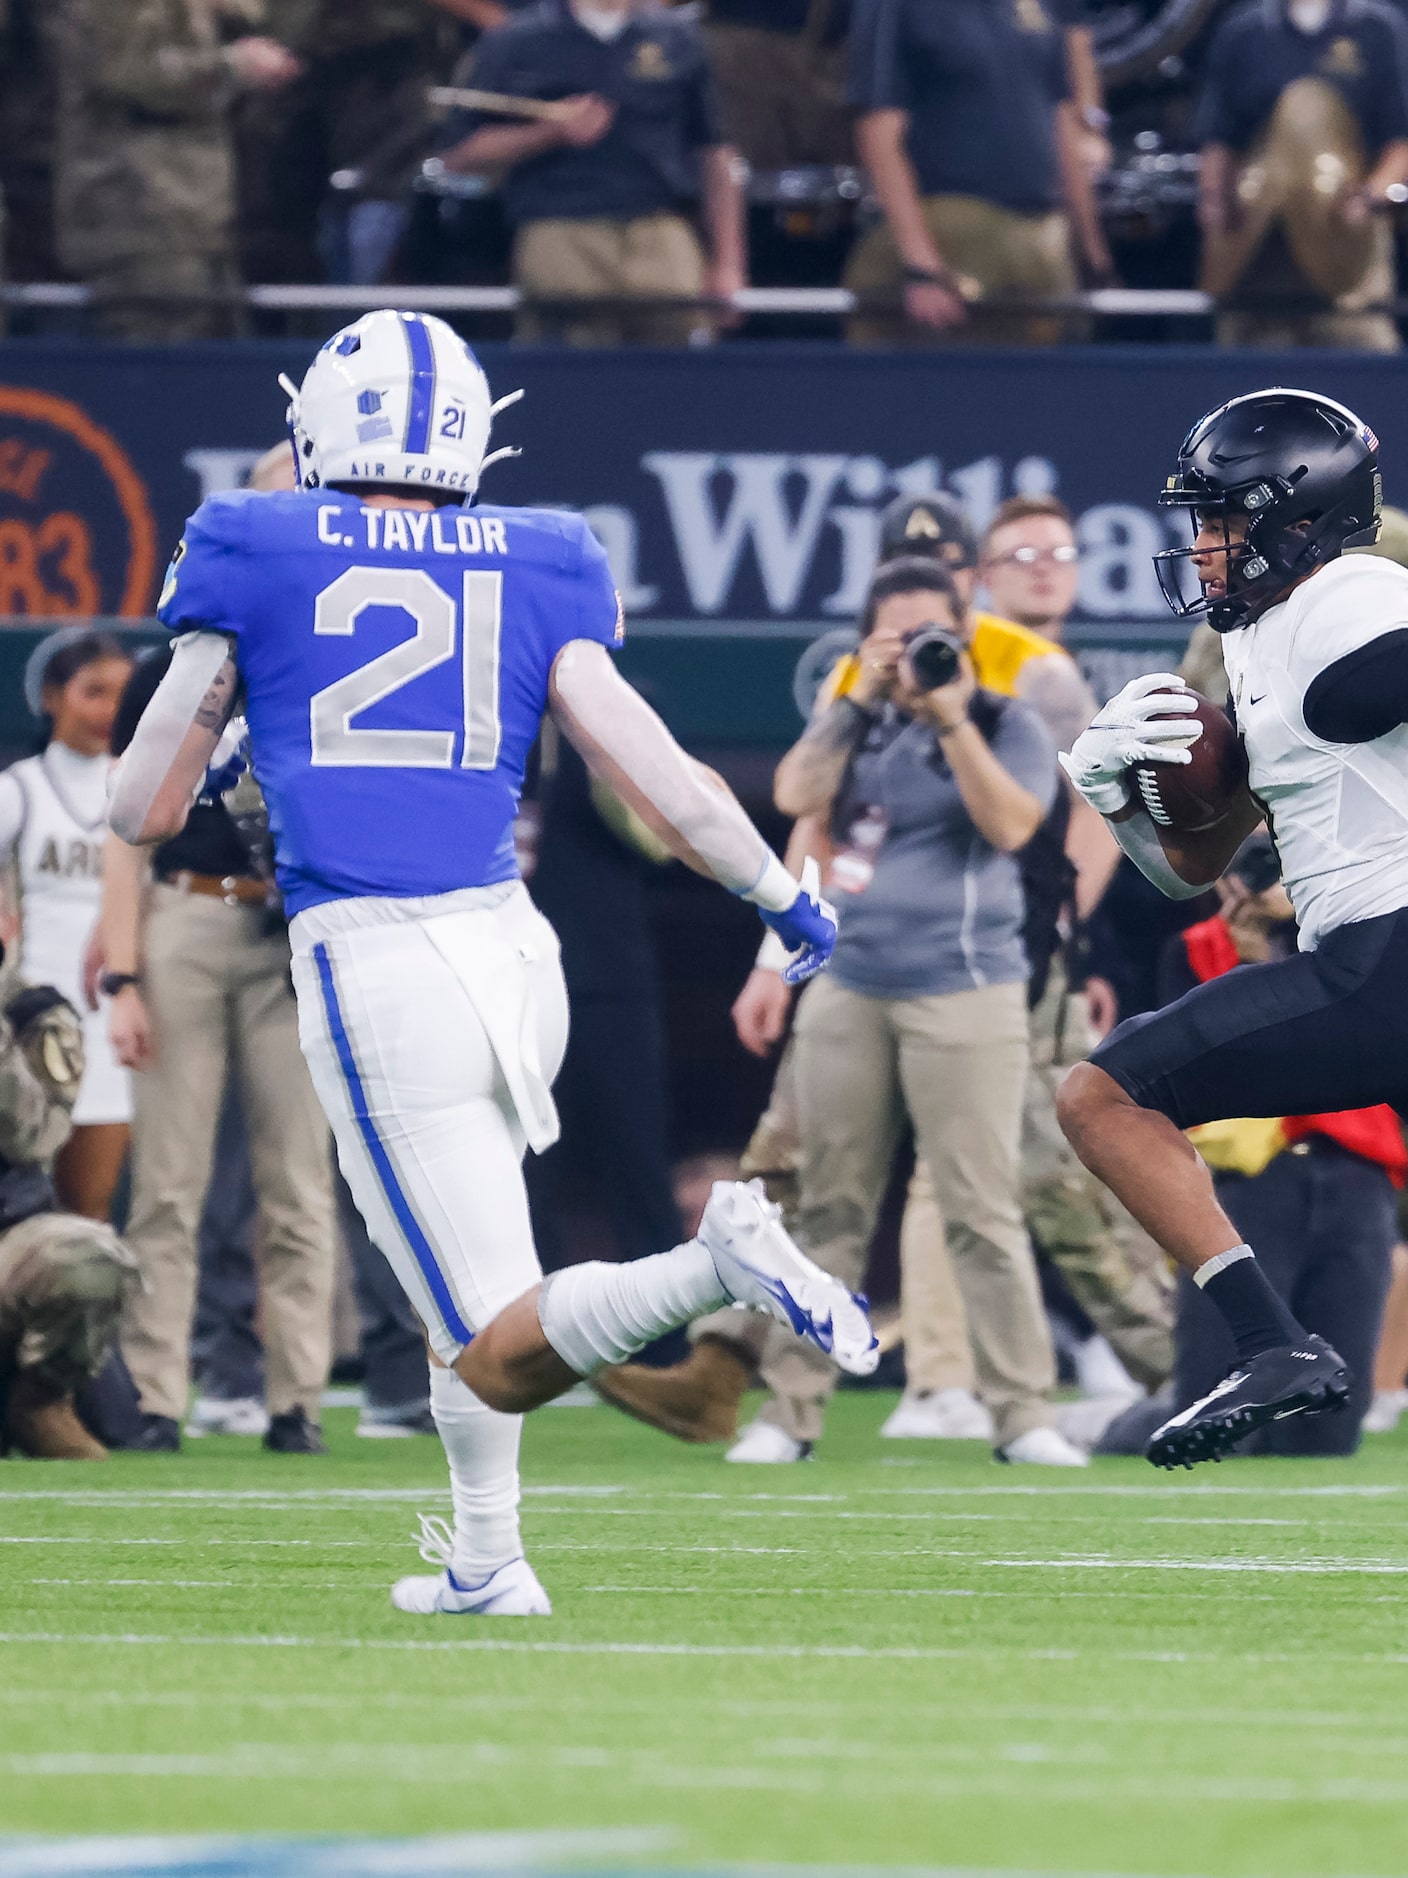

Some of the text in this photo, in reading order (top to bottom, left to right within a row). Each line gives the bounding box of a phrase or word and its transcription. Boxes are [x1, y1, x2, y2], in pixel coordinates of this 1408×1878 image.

[440, 406, 466, 440] 21
[351, 461, 472, 488] AIR FORCE
[316, 505, 508, 555] C. TAYLOR
[310, 565, 503, 771] 21
